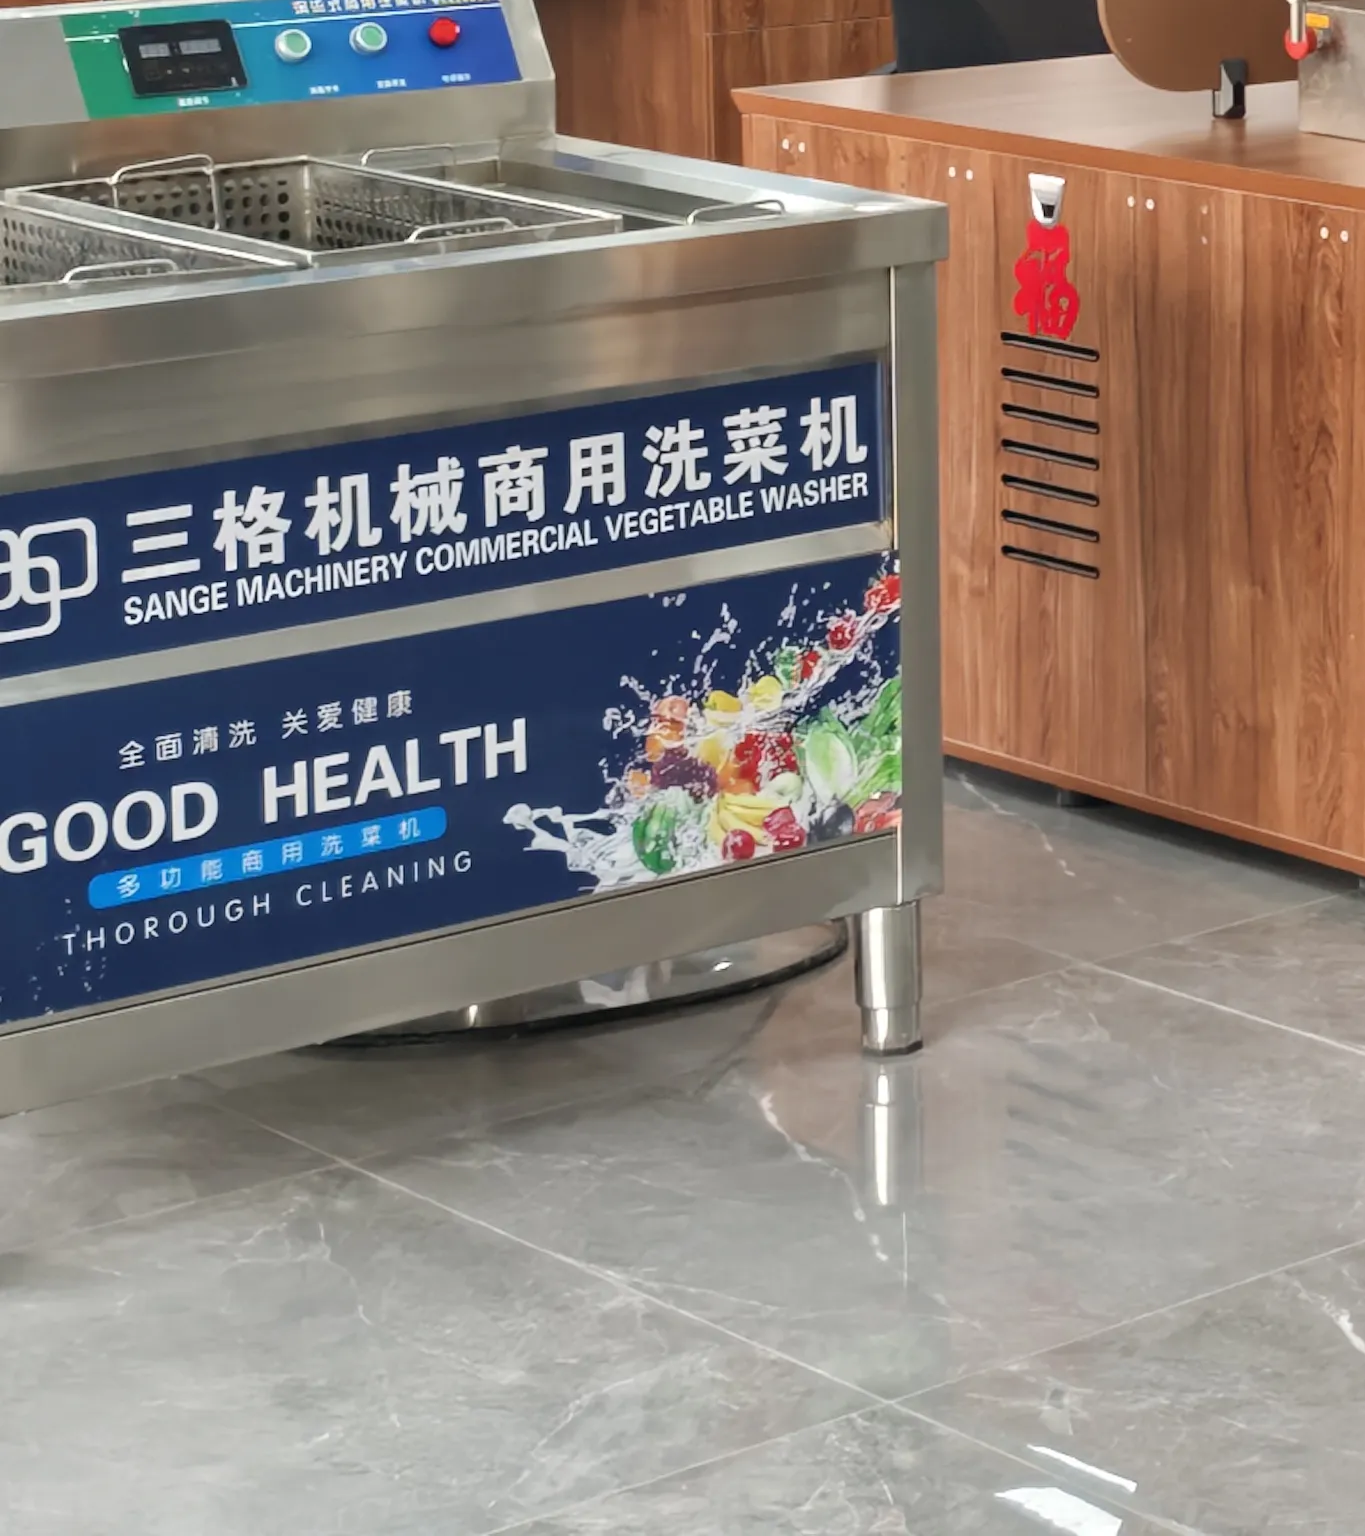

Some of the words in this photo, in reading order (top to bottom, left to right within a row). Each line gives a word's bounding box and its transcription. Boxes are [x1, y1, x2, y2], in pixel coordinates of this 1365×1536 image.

[121, 392, 869, 586] 三格机械商用洗菜机
[124, 577, 229, 626] SANGE
[236, 550, 408, 607] MACHINERY
[415, 519, 599, 575] COMMERCIAL
[604, 490, 754, 542] VEGETABLE
[760, 471, 870, 514] WASHER
[118, 719, 257, 770] 全面清洗
[282, 688, 414, 739] 关爱健康
[0, 781, 219, 874] GOOD
[262, 717, 528, 824] HEALTH
[116, 816, 422, 899] 多功能商用洗菜机
[62, 891, 271, 955] THOROUGH
[296, 850, 474, 907] CLEANING
